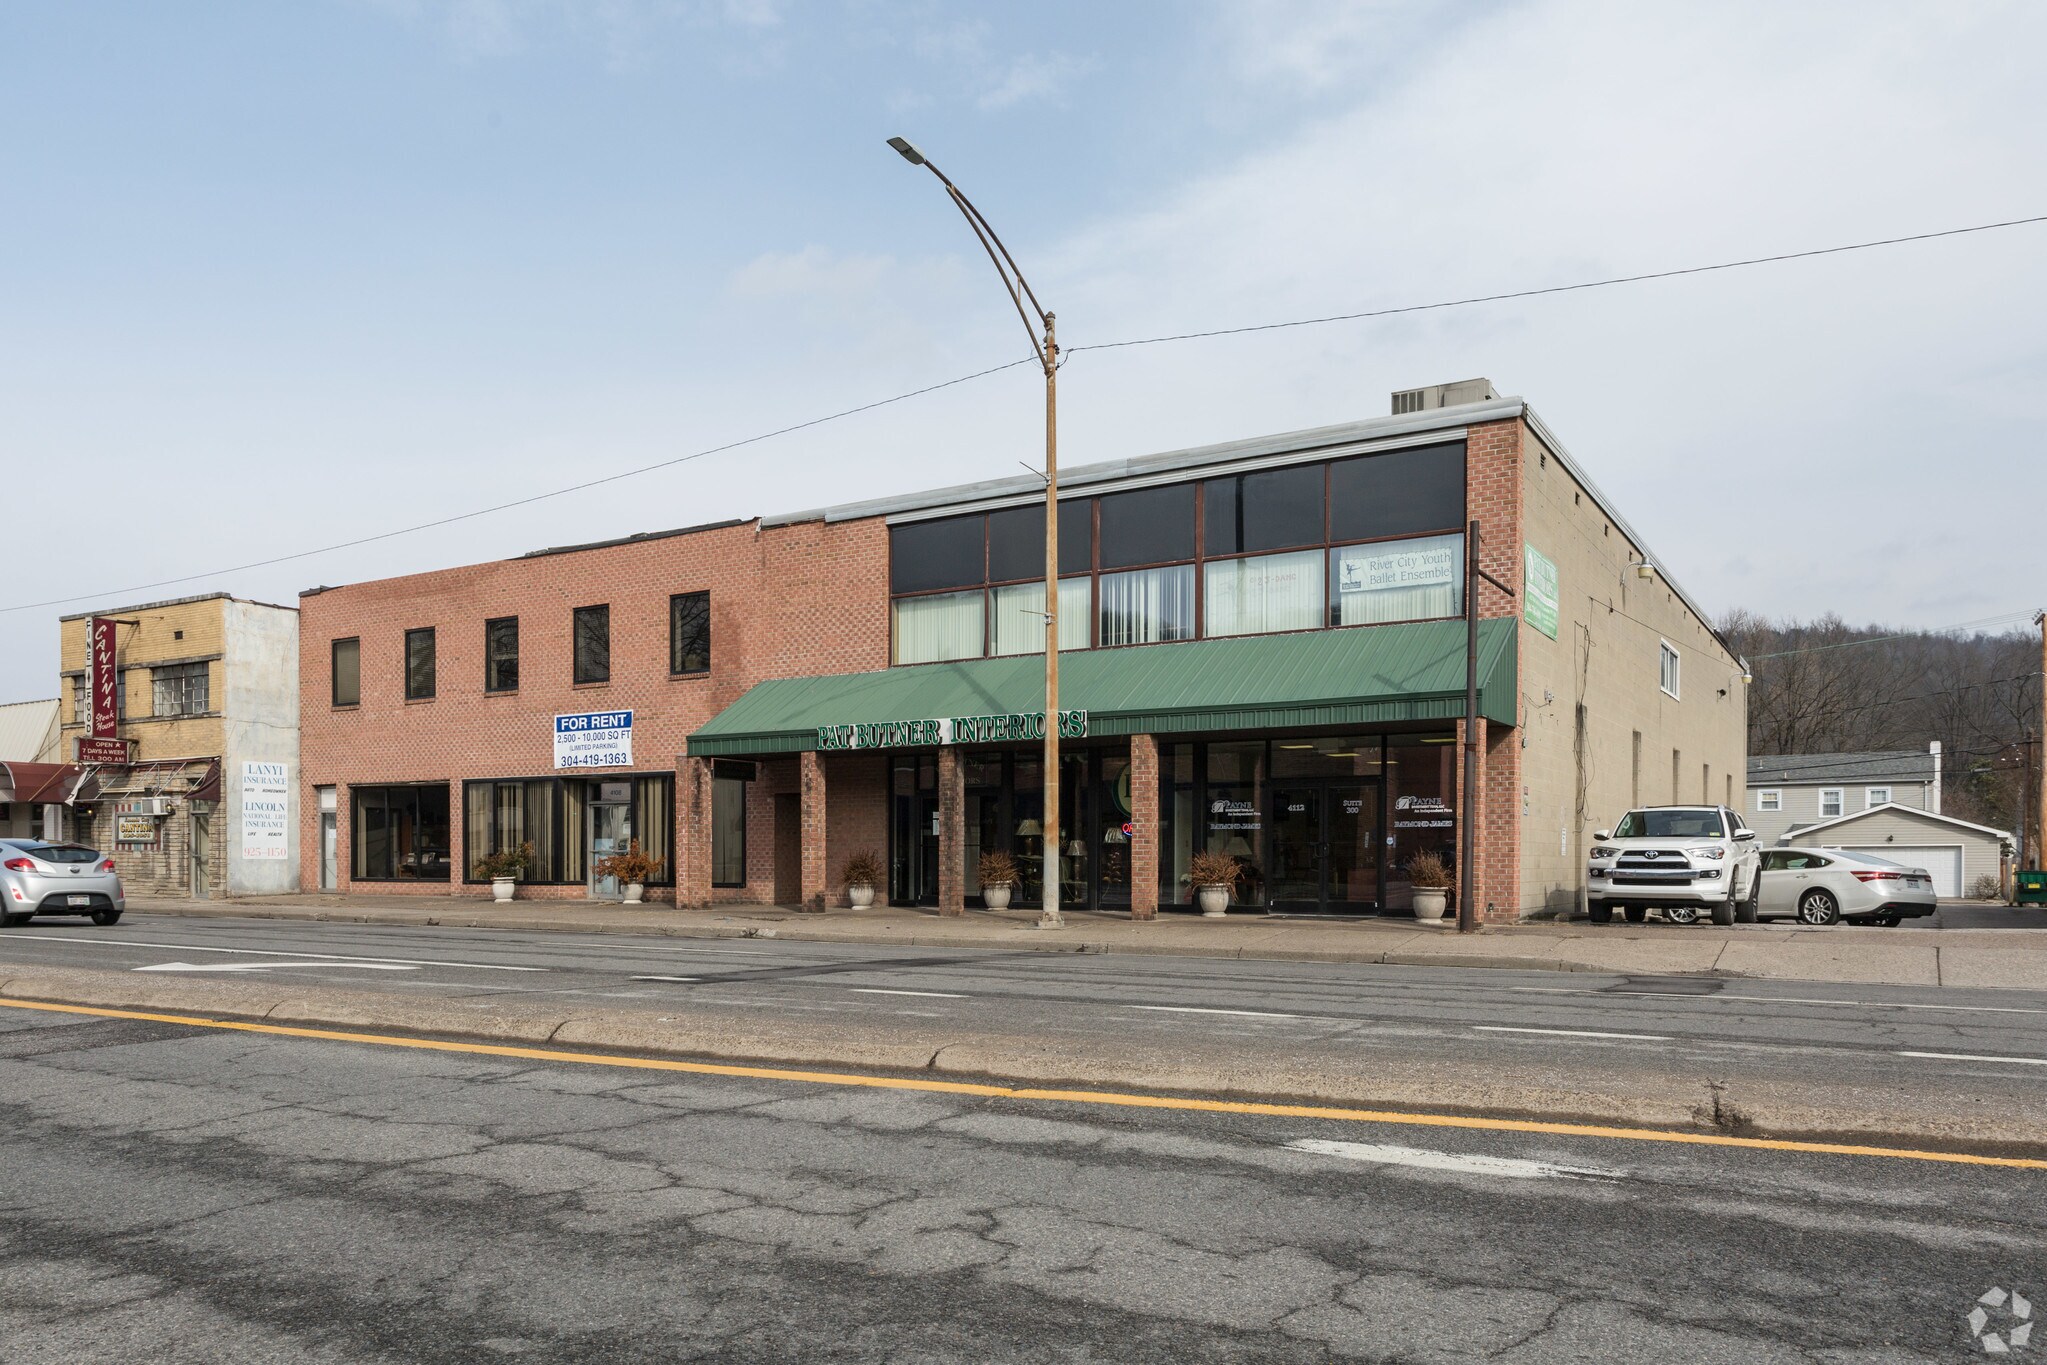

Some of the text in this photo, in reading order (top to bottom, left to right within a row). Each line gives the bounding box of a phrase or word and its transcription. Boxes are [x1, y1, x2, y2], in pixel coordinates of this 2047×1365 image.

[1370, 552, 1450, 570] River City Youth
[1370, 567, 1450, 585] Ballet Ensemble
[94, 624, 113, 708] CANTINA
[96, 710, 114, 722] Steak
[561, 714, 627, 730] FOR RENT
[96, 720, 114, 732] House
[558, 734, 576, 744] 2,500
[583, 732, 606, 742] 10,000
[608, 730, 618, 740] SQ
[621, 730, 630, 739] FT
[817, 724, 851, 750] PAT
[855, 720, 940, 748] BUTNER
[561, 752, 627, 766] 304-419-1363
[248, 764, 282, 776] LANYI
[244, 776, 286, 785] INSURANCE
[245, 802, 286, 812] LINCOLN
[120, 823, 154, 833] CANTINA
[244, 848, 286, 857] 925-1150
